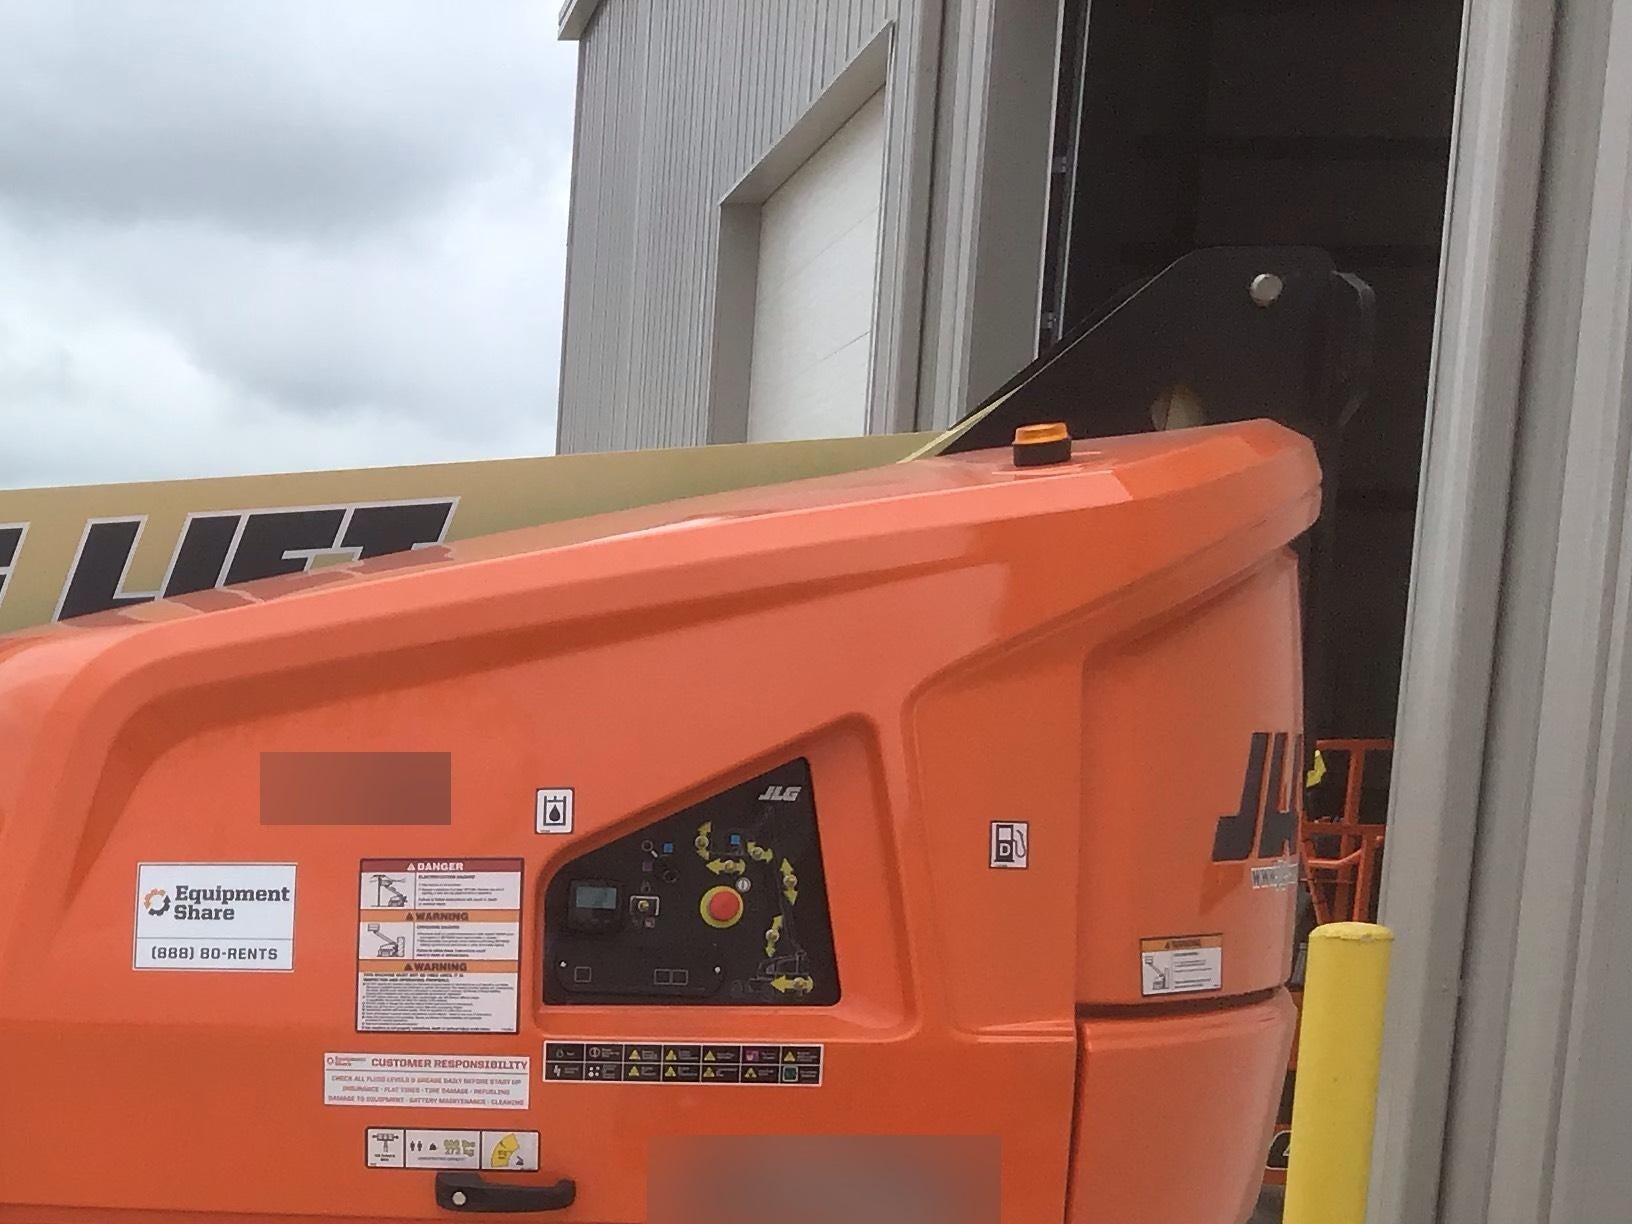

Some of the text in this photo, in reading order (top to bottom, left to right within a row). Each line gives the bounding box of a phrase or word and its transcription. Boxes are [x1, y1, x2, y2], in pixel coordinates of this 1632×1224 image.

[758, 786, 802, 801] JLG
[1212, 732, 1303, 862] JL
[417, 862, 464, 871] DANGER
[175, 885, 290, 905] Equipment
[174, 904, 235, 920] Share
[415, 912, 469, 922] WARNING
[151, 946, 278, 960] (888) 80-RENTS
[413, 962, 468, 972] WARNING
[371, 1057, 432, 1068] CUSTOMER
[434, 1059, 528, 1070] RESPONSIBILITY
